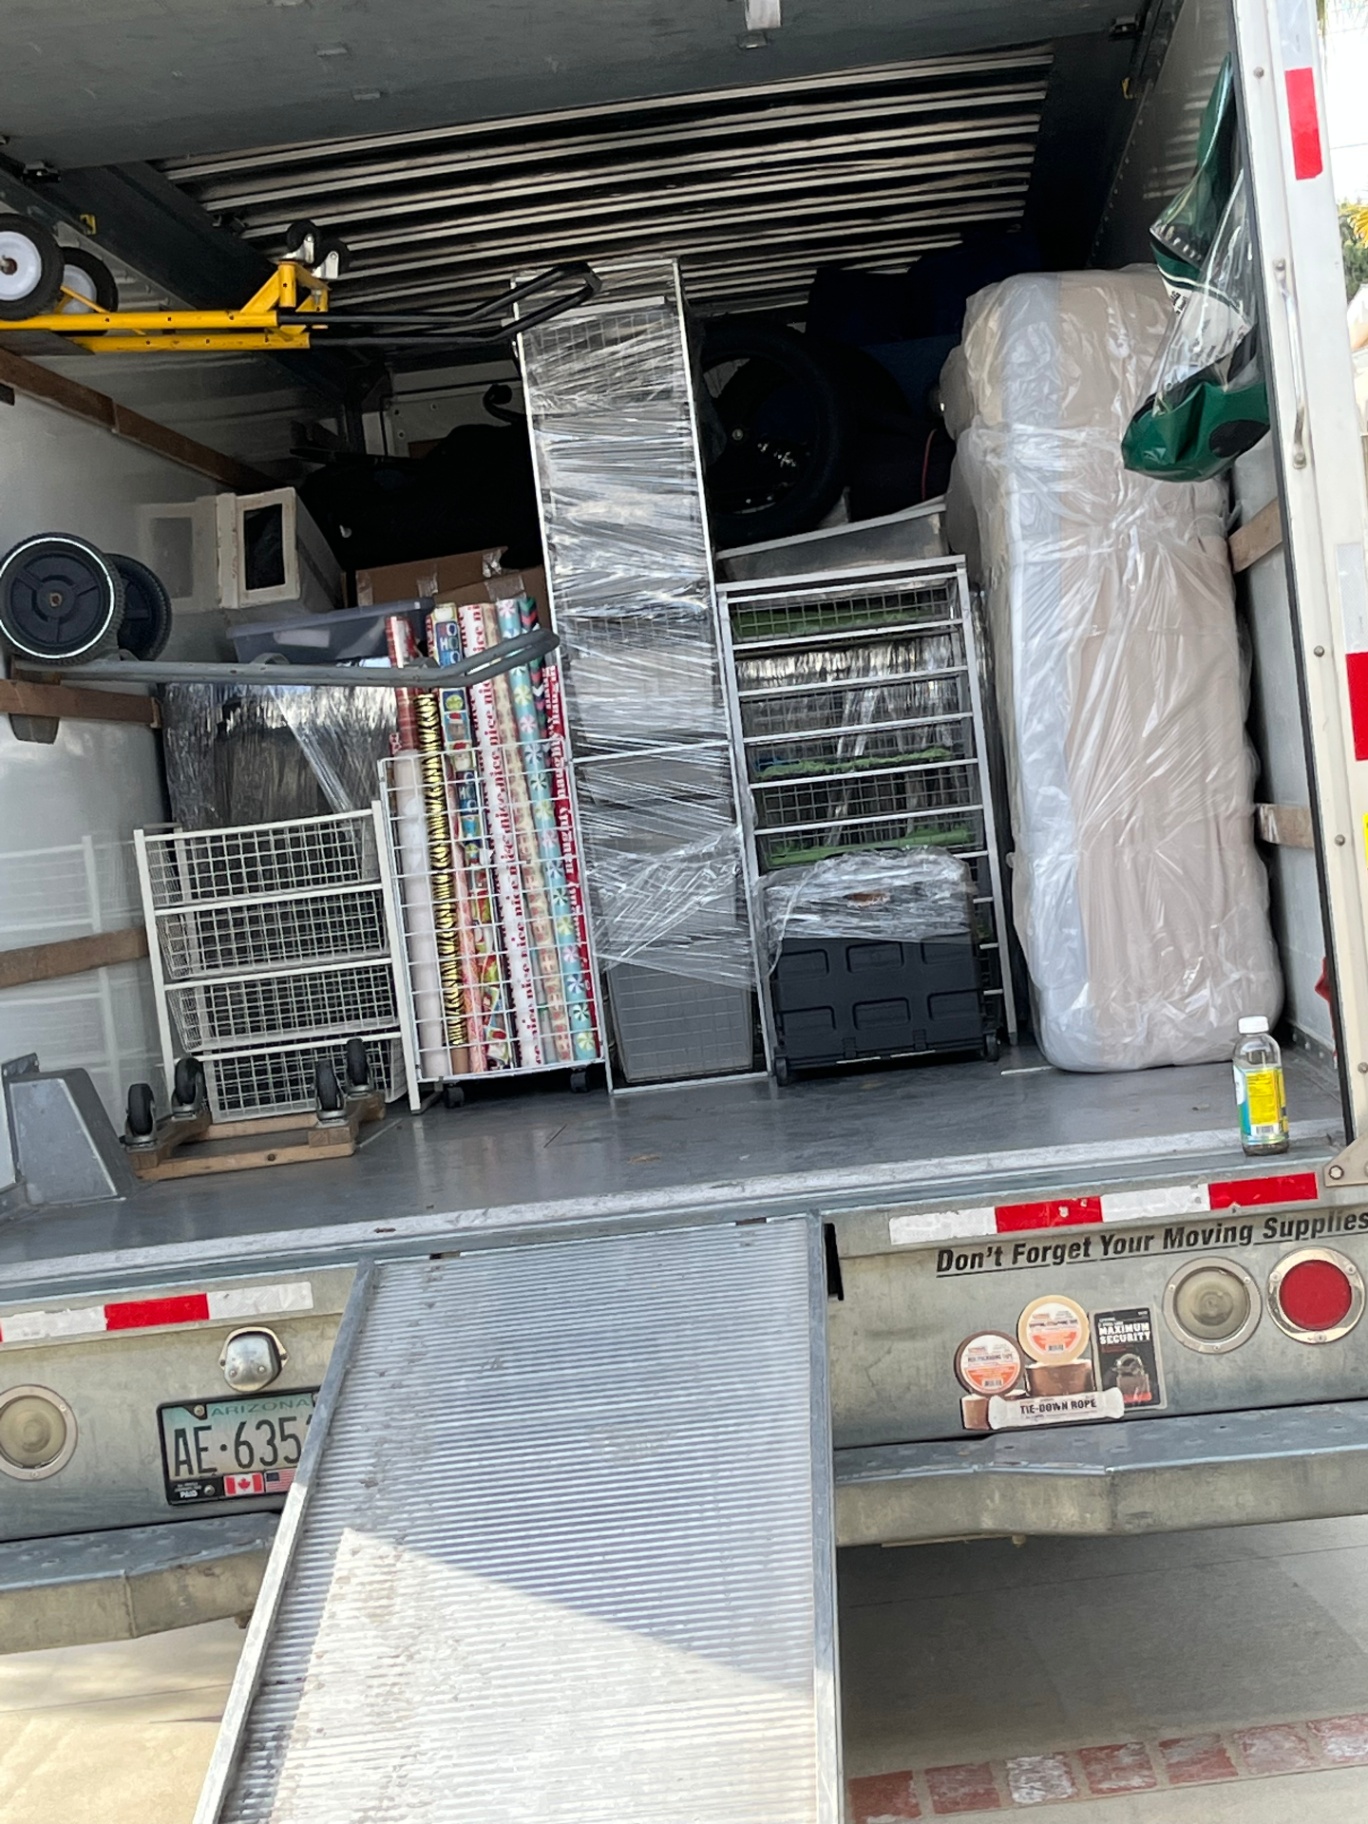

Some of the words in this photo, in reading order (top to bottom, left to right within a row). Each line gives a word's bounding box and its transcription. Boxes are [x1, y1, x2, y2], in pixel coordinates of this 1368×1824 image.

[440, 635, 459, 652] HO
[484, 708, 498, 747] nice
[936, 1246, 1003, 1274] Don't
[1012, 1236, 1092, 1266] Forget
[1101, 1233, 1155, 1256] Your
[1163, 1223, 1253, 1249] Moving
[1263, 1210, 1368, 1240] Supplies
[1099, 1321, 1150, 1337] MAXIMUM
[1099, 1331, 1151, 1345] SECURITY
[211, 1398, 310, 1417] ARIZONA
[1070, 1398, 1098, 1410] ROPE
